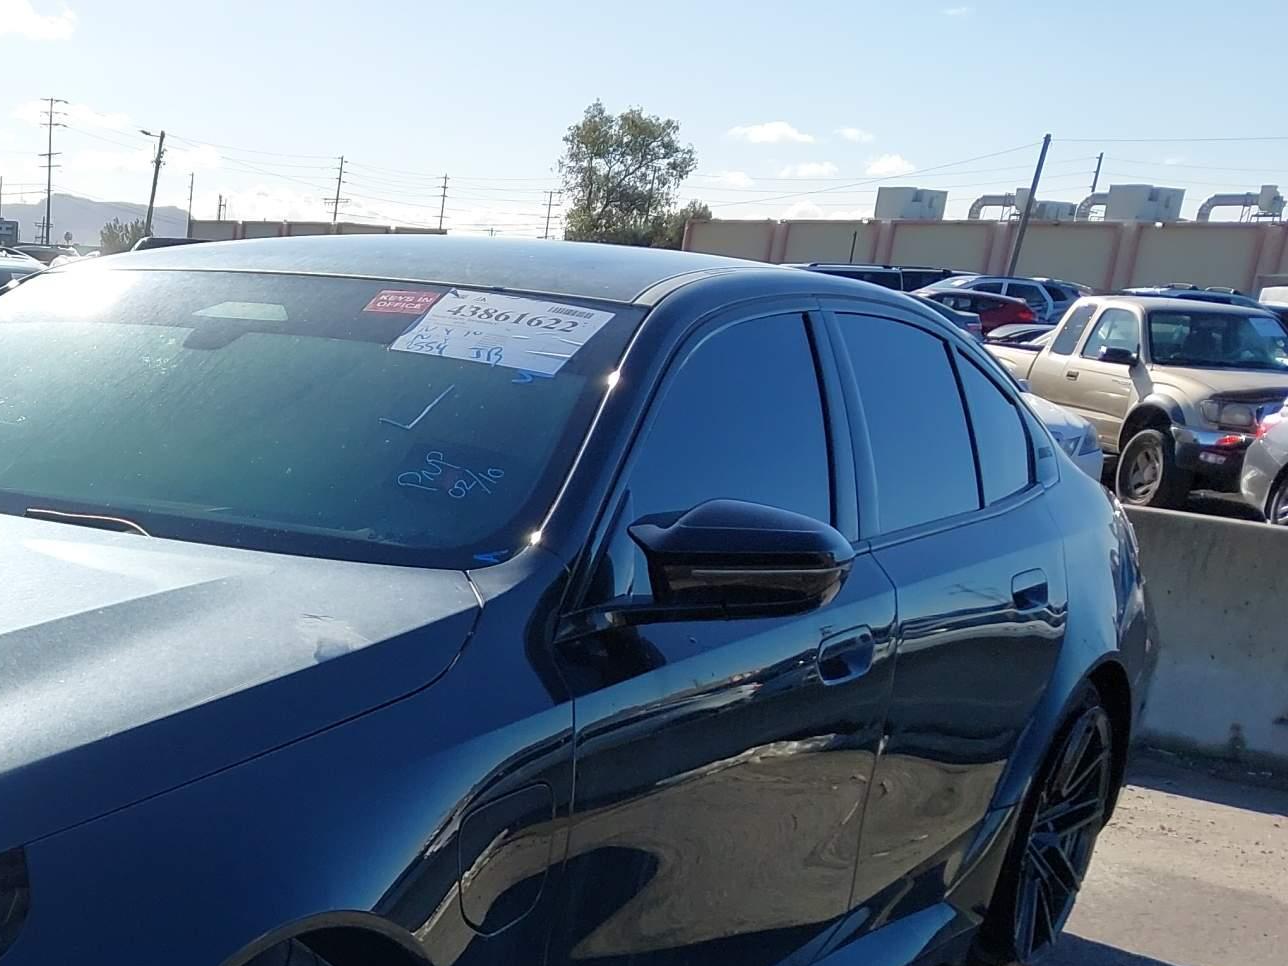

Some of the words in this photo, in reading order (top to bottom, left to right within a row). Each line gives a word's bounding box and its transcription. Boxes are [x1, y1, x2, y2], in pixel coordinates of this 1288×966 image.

[379, 294, 413, 303] KEYS
[417, 295, 433, 304] IN
[376, 301, 422, 310] OFFICE
[446, 304, 579, 333] 43861622
